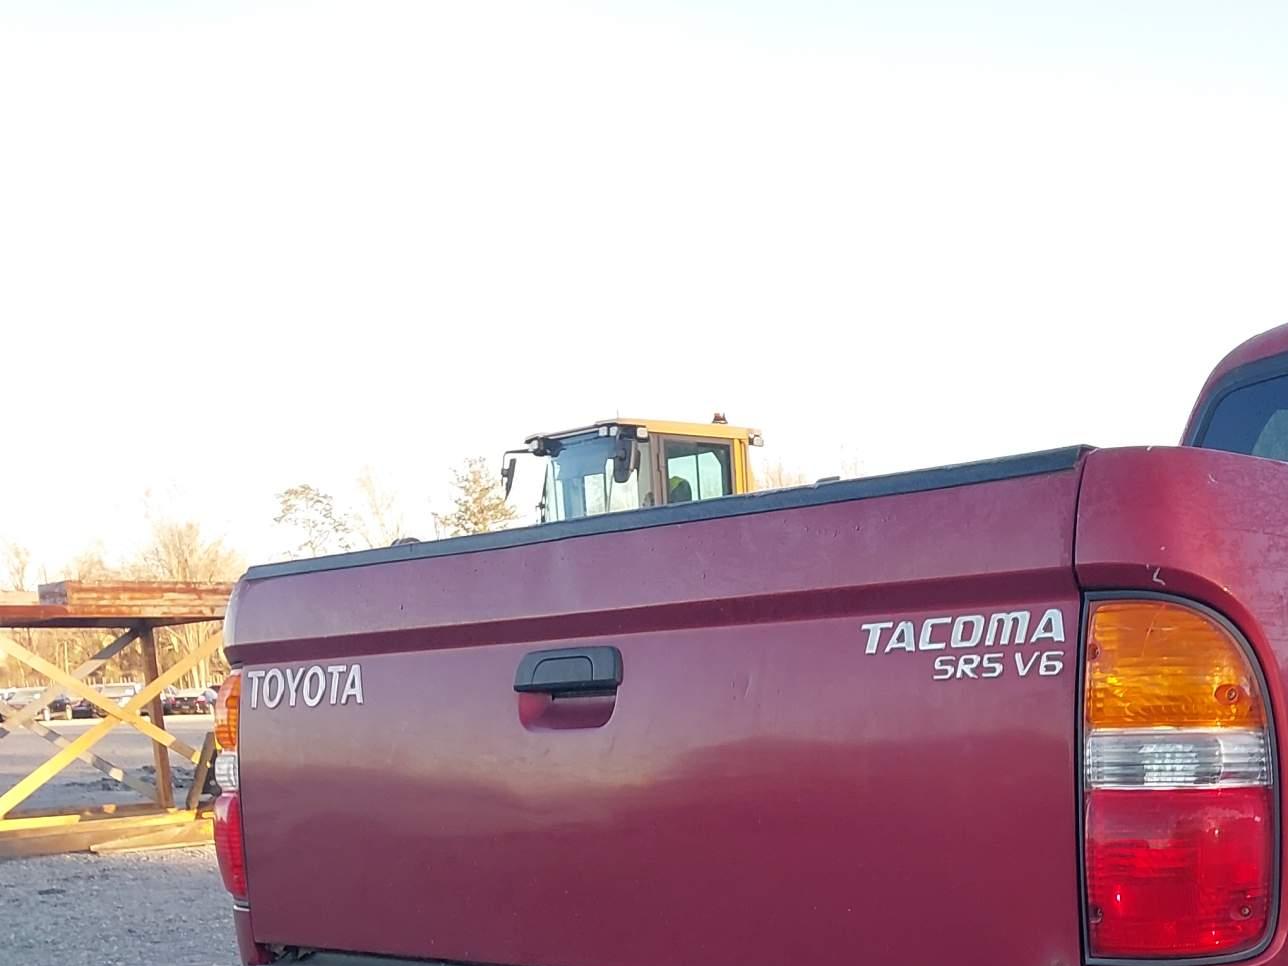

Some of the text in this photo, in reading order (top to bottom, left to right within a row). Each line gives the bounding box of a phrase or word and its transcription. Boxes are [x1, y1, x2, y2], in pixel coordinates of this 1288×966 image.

[861, 608, 1065, 655] TACOMA
[247, 664, 365, 710] TOYOTA
[933, 650, 1065, 680] SR5 V6
